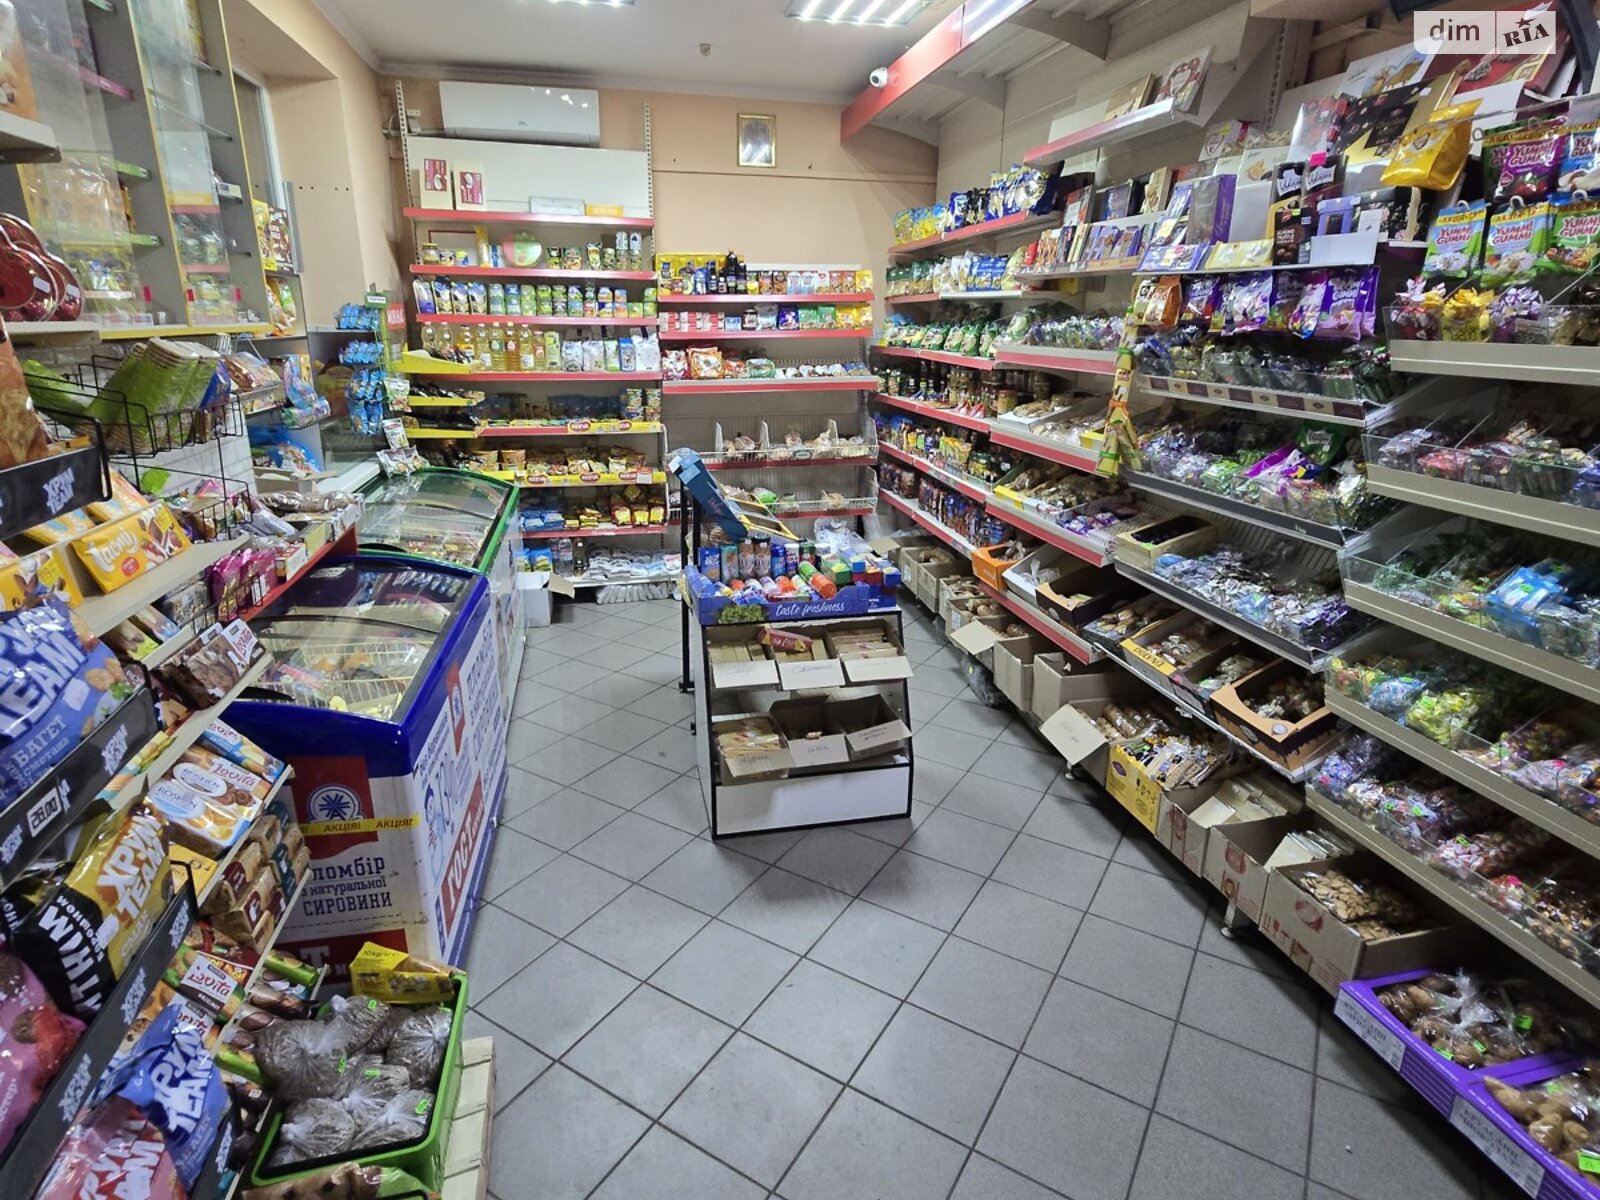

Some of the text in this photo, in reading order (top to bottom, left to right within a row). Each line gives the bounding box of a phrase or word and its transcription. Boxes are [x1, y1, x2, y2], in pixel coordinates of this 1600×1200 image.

[775, 601, 845, 617] taste freshness
[11, 714, 66, 768] БАГЕТ
[181, 767, 221, 790] ROSHEN
[212, 763, 257, 788] Lovita
[157, 786, 197, 809] ROSN
[324, 817, 413, 833] АКЦІЯ! АКЦІЯ!
[97, 814, 163, 898] ХРУМ
[312, 856, 385, 881] ломбір
[310, 875, 388, 896] натуральної
[303, 892, 393, 917] СИРОВИНИ
